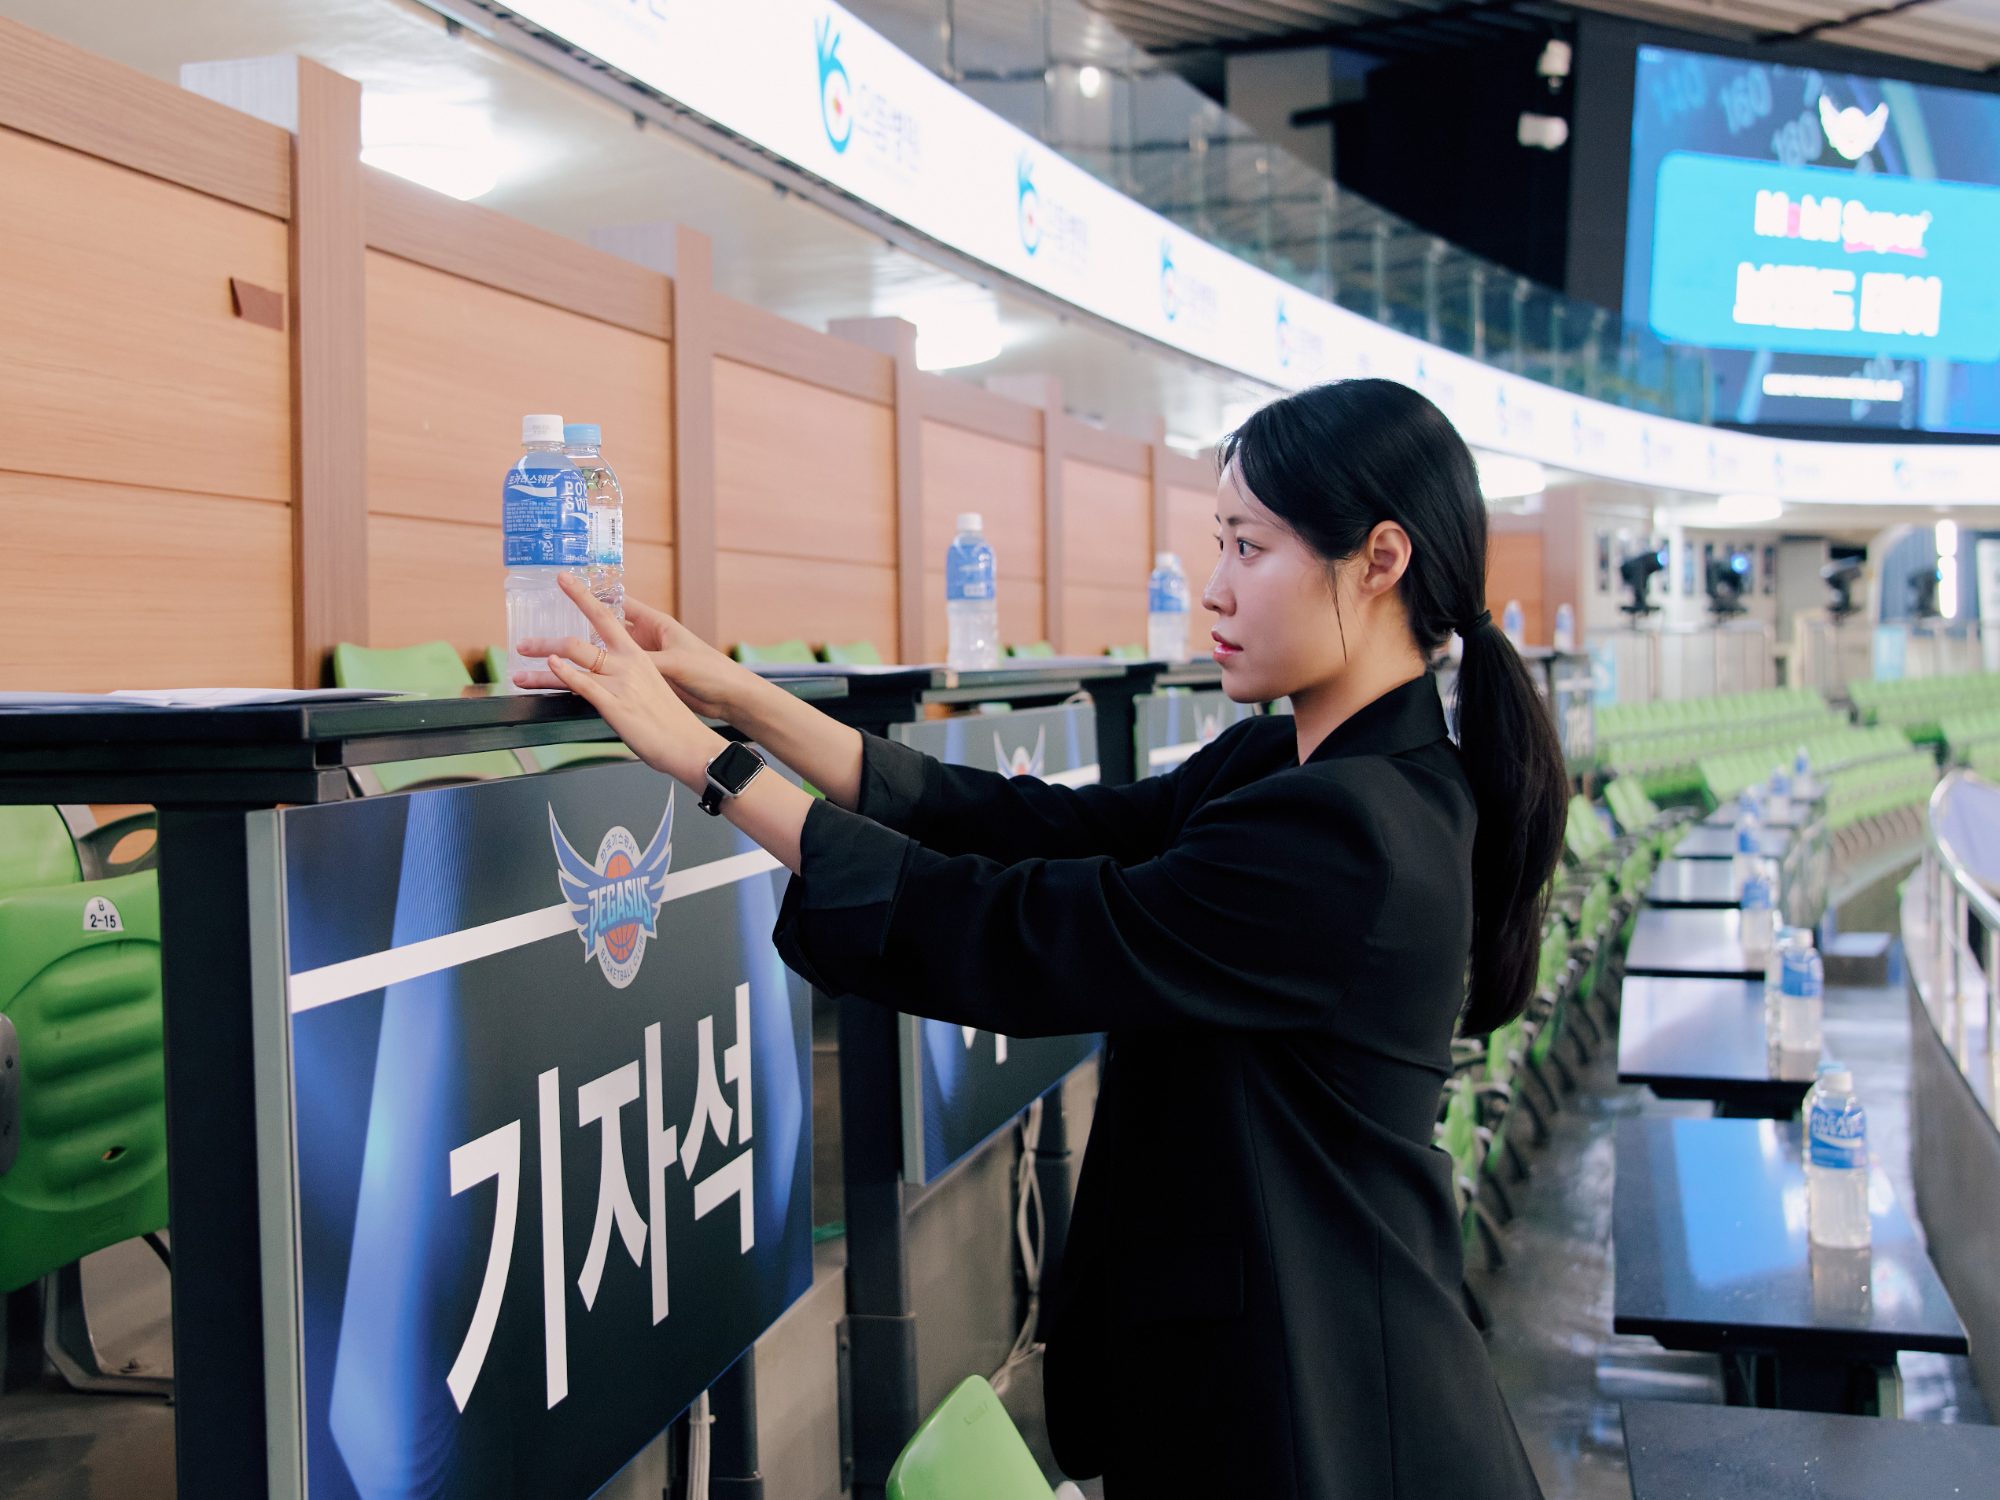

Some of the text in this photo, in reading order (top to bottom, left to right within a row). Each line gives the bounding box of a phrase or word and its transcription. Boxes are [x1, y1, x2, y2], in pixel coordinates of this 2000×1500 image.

[564, 496, 588, 511] SW
[90, 913, 117, 929] 2-15
[587, 876, 650, 952] PEGASUS
[601, 948, 634, 981] BASKETBALL
[446, 981, 755, 1414] 기자석
